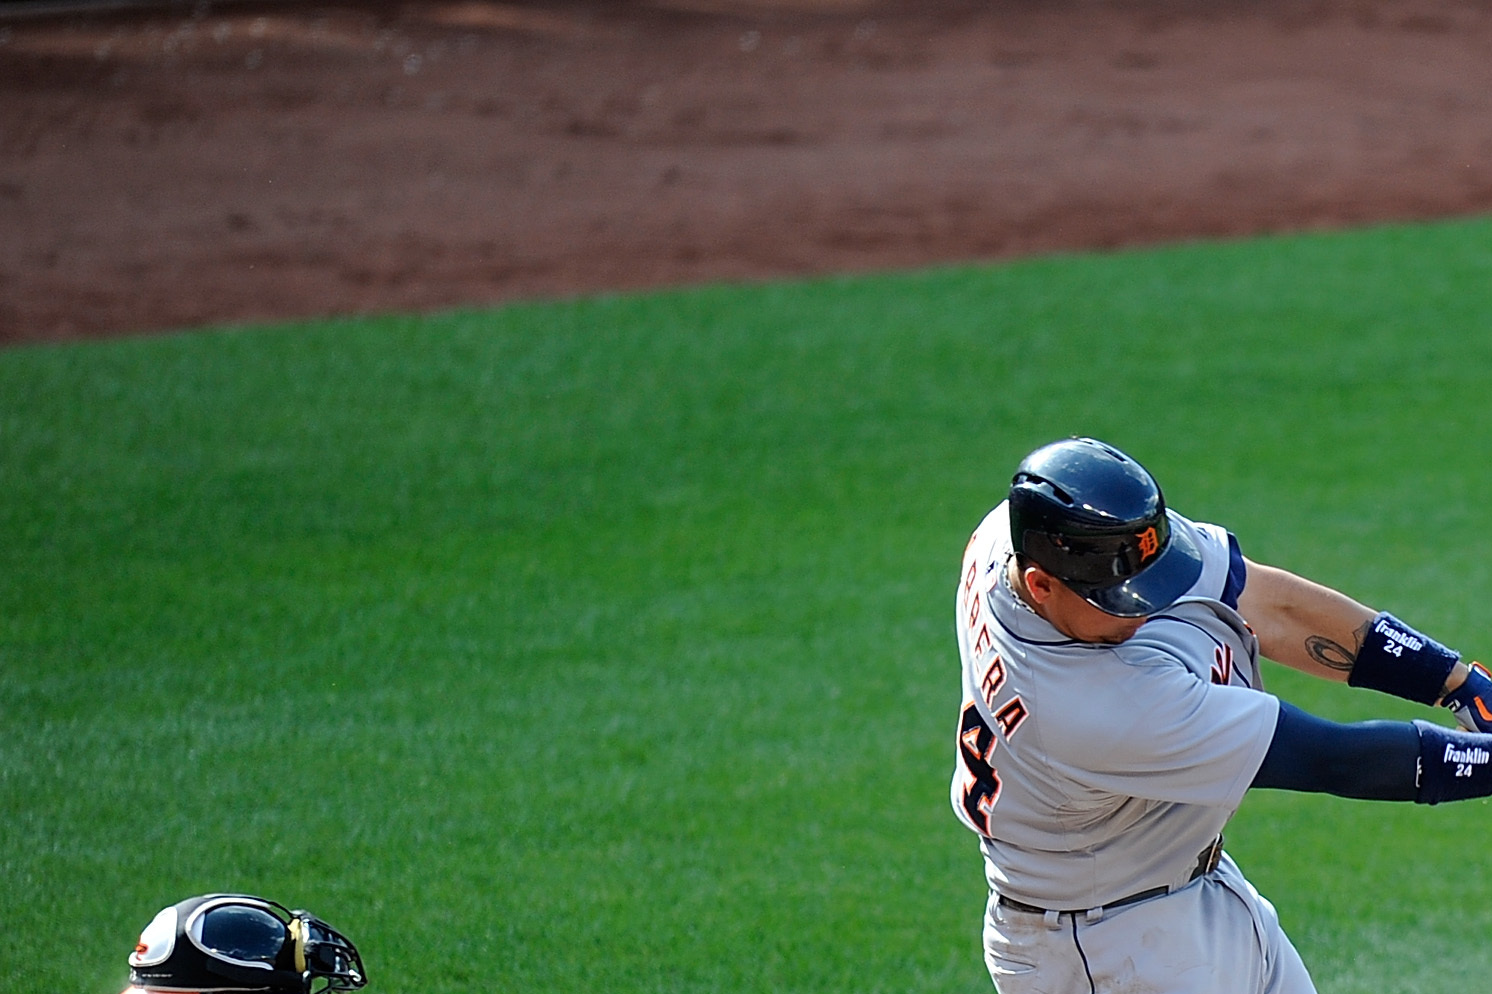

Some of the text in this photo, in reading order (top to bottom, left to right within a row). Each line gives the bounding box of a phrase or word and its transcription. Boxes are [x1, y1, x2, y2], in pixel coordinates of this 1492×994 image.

[1375, 620, 1422, 651] Franklin
[1383, 640, 1403, 657] 24
[1444, 743, 1489, 764] Franklin
[1455, 764, 1472, 777] 24
